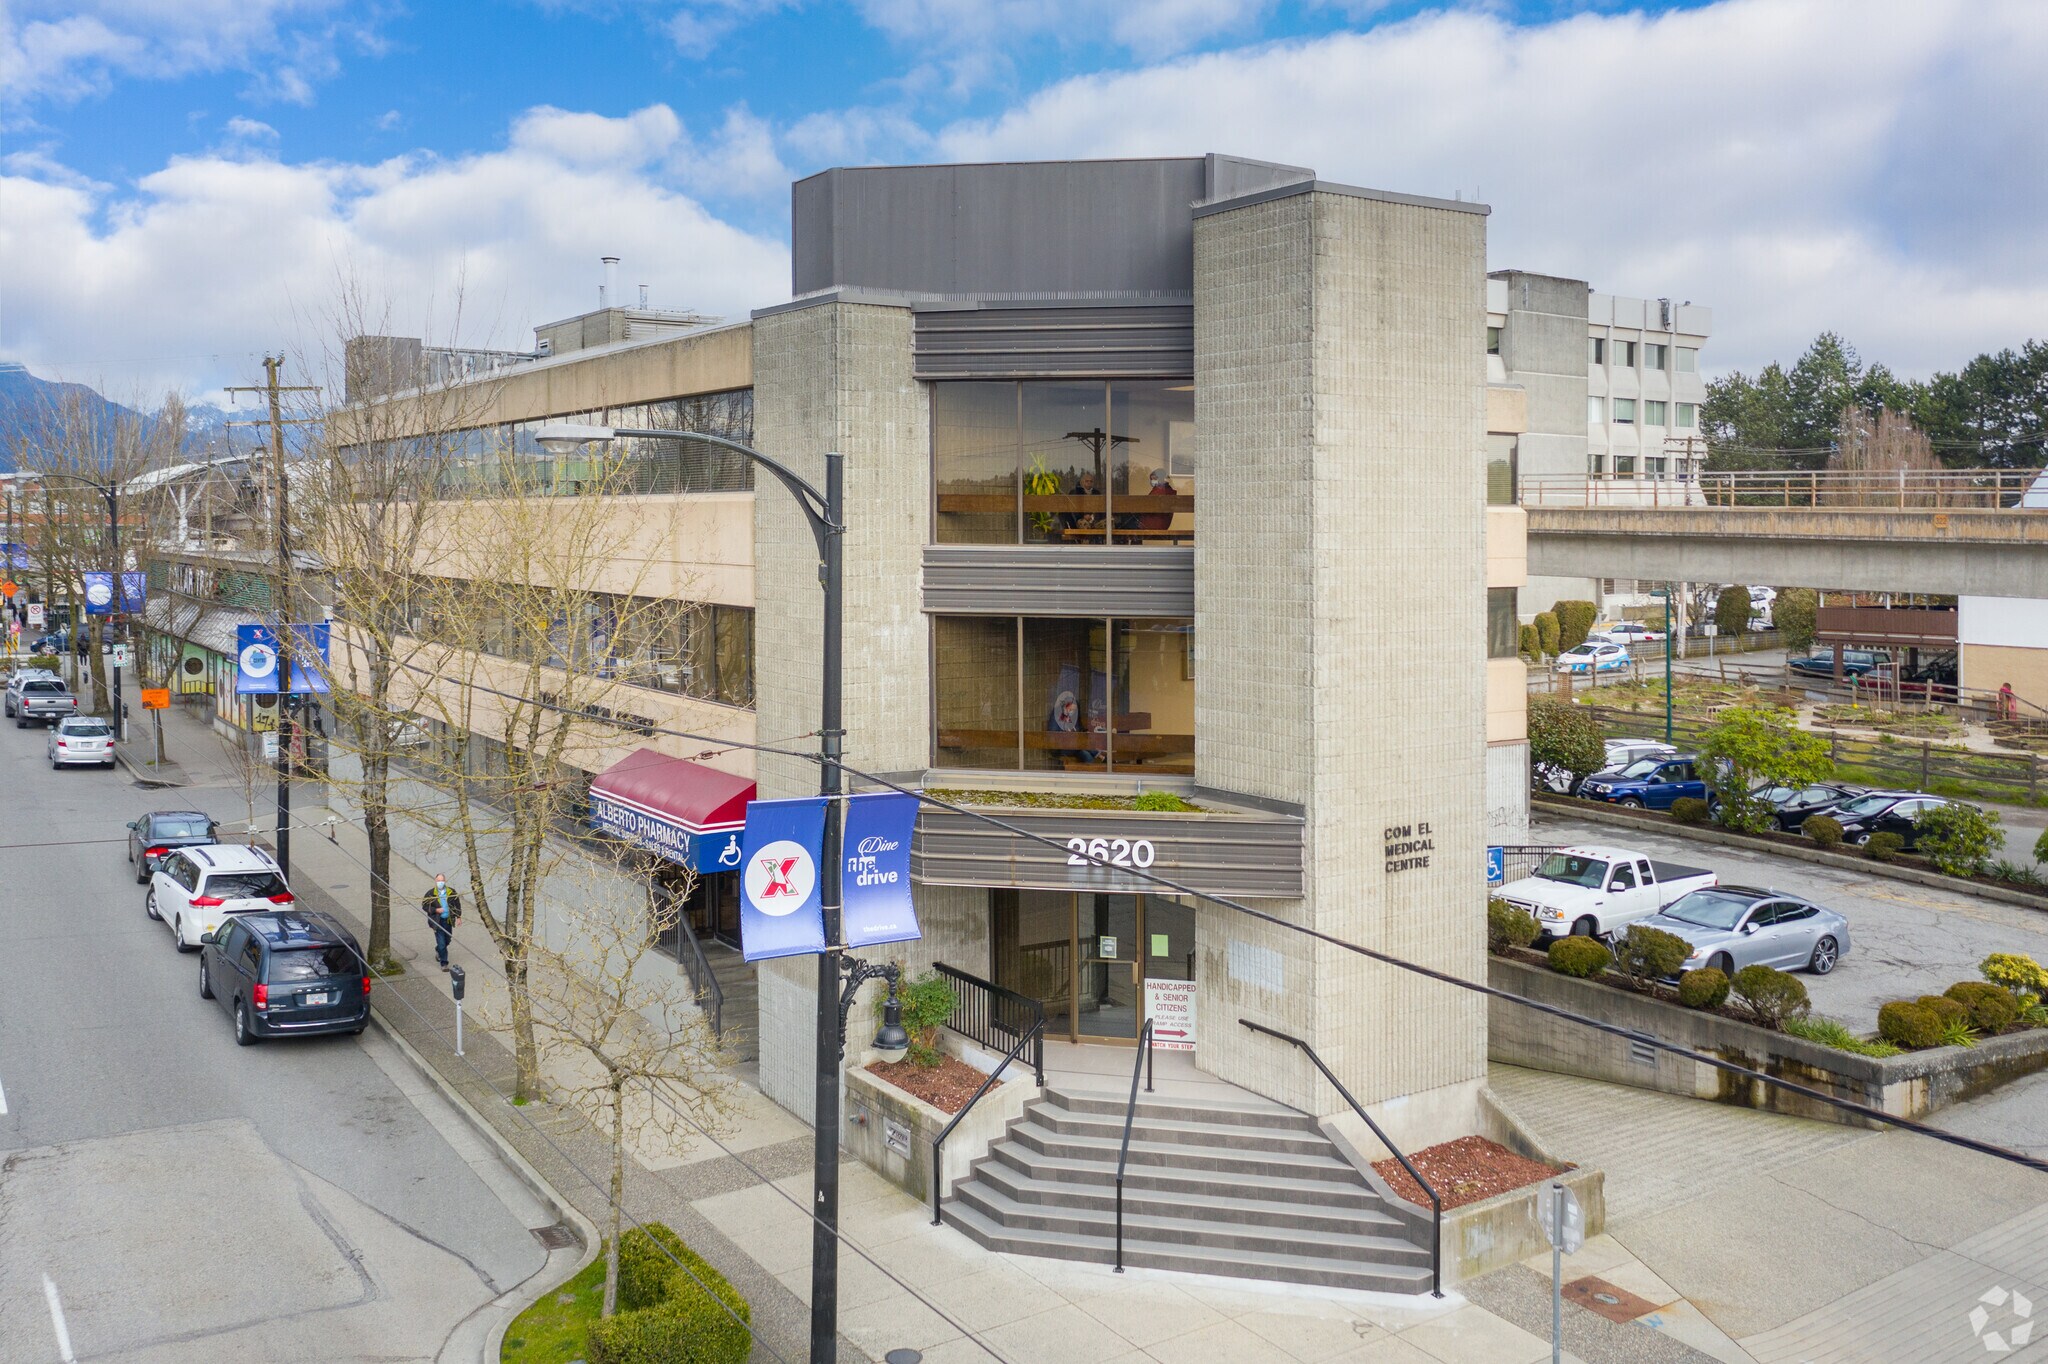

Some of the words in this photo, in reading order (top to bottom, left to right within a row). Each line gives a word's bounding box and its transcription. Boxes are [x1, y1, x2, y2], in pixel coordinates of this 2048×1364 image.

[597, 801, 636, 831] ALBERTO
[638, 816, 690, 852] PHARMACY
[1384, 825, 1411, 840] COM
[1418, 822, 1433, 836] EL
[858, 836, 899, 858] Dine
[1067, 838, 1155, 868] 2620
[1385, 839, 1435, 856] MEDICAL
[848, 857, 876, 873] the
[1385, 856, 1430, 873] CENTRE
[856, 869, 898, 886] drive
[1146, 982, 1196, 992] HANDICAPPED
[1163, 994, 1189, 1002] SENIOR
[1156, 1003, 1187, 1012] CITIZENS
